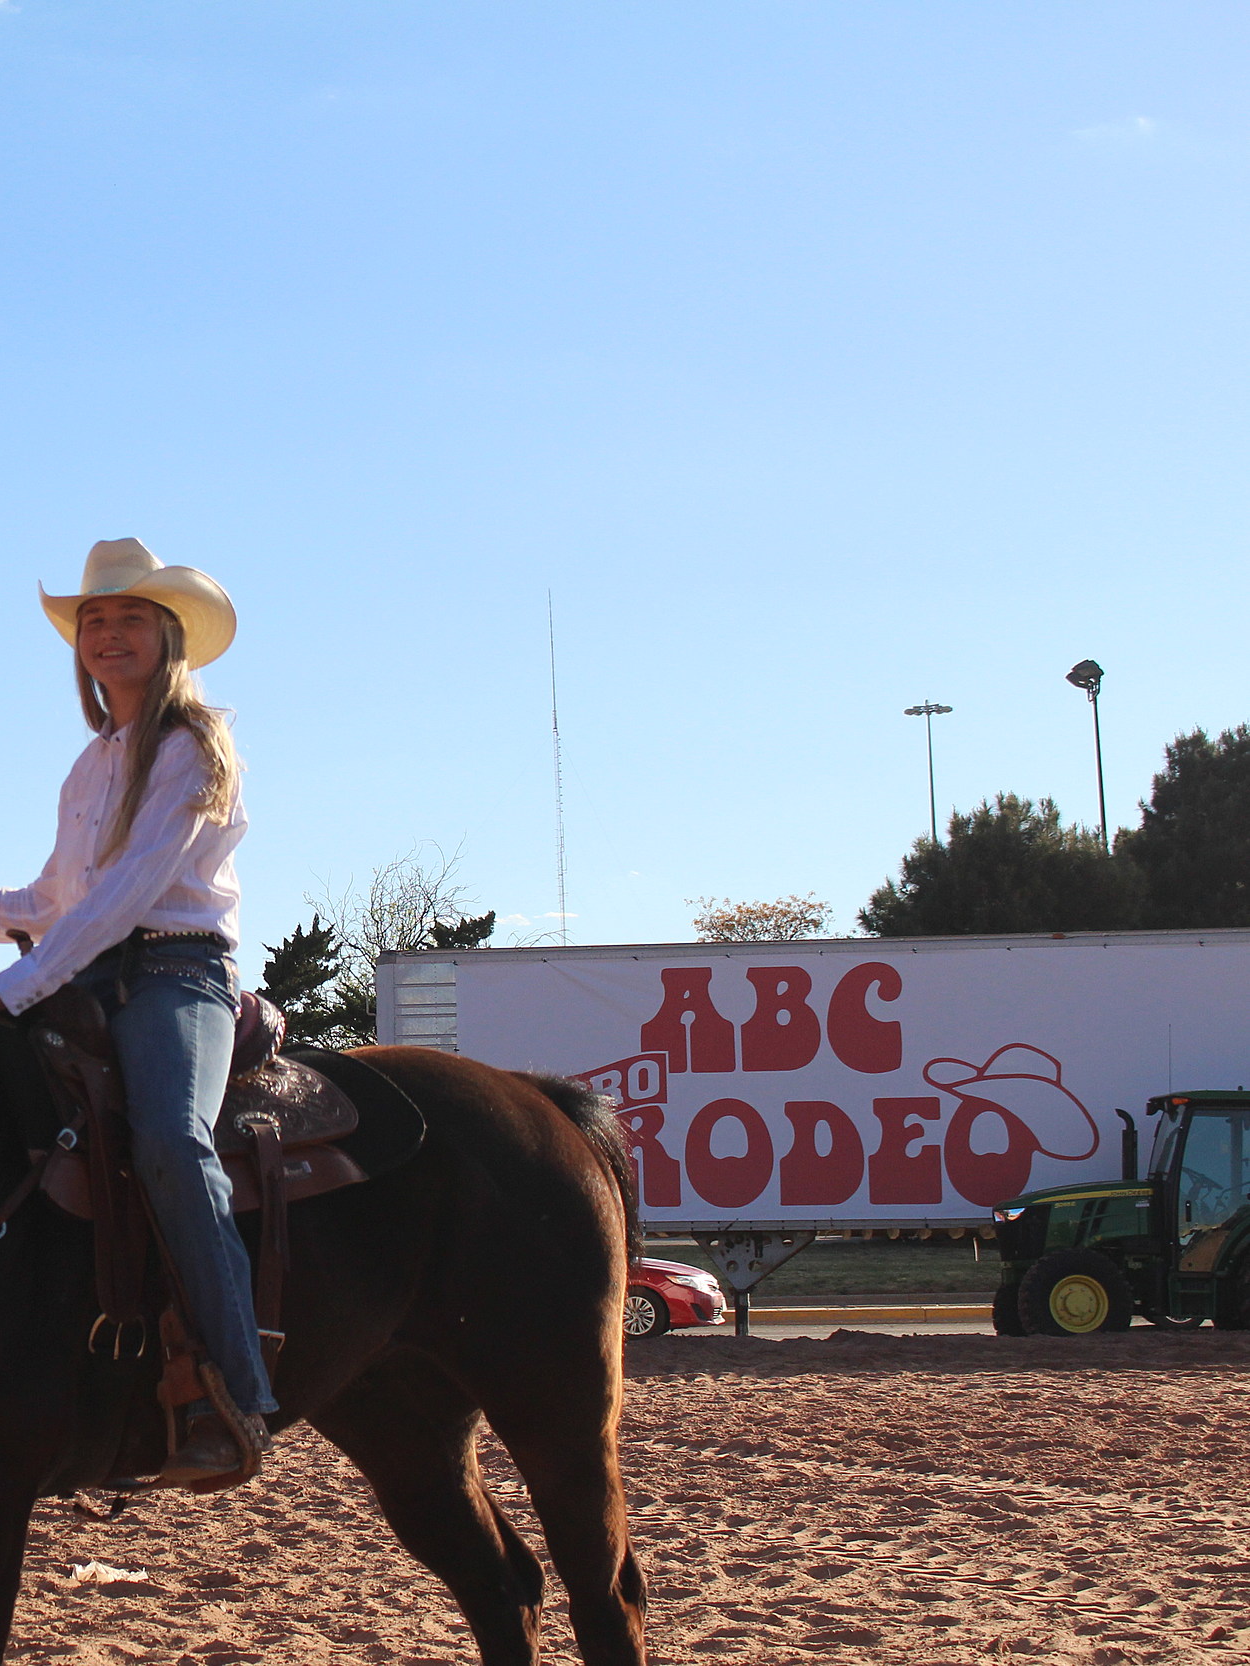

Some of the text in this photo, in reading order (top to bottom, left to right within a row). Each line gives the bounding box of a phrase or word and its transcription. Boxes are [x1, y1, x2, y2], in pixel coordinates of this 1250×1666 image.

[641, 961, 903, 1074] ABC
[579, 1060, 660, 1105] RO
[616, 1097, 1032, 1208] RODEO
